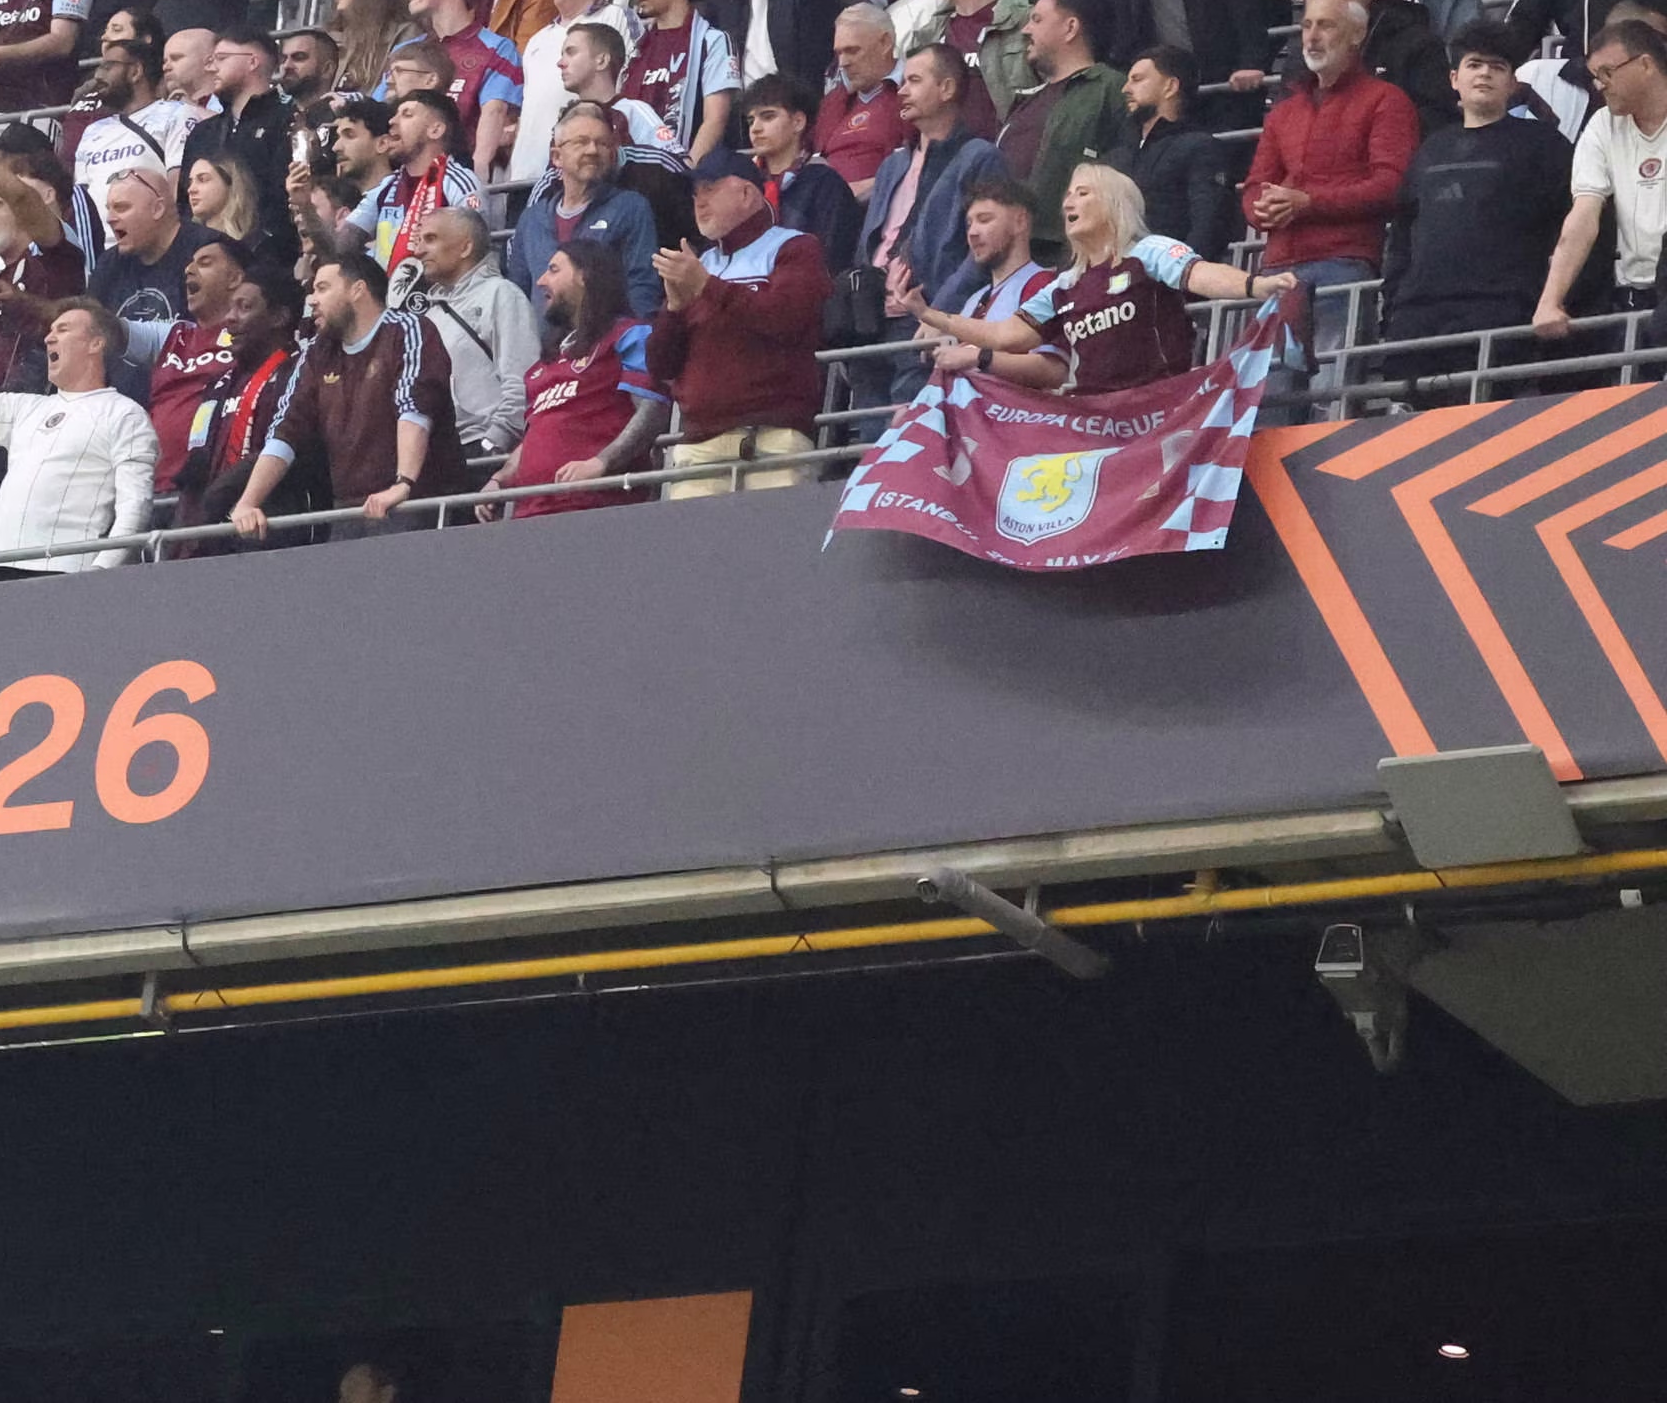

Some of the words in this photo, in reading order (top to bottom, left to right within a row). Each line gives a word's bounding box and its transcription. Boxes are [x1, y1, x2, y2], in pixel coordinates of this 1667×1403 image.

[1062, 300, 1137, 347] Betano
[985, 403, 1068, 429] EUROPA
[1071, 410, 1166, 439] LEAGUE
[874, 492, 980, 543] ISTANB
[1003, 516, 1035, 534] ASTON
[1037, 516, 1076, 534] VILLA
